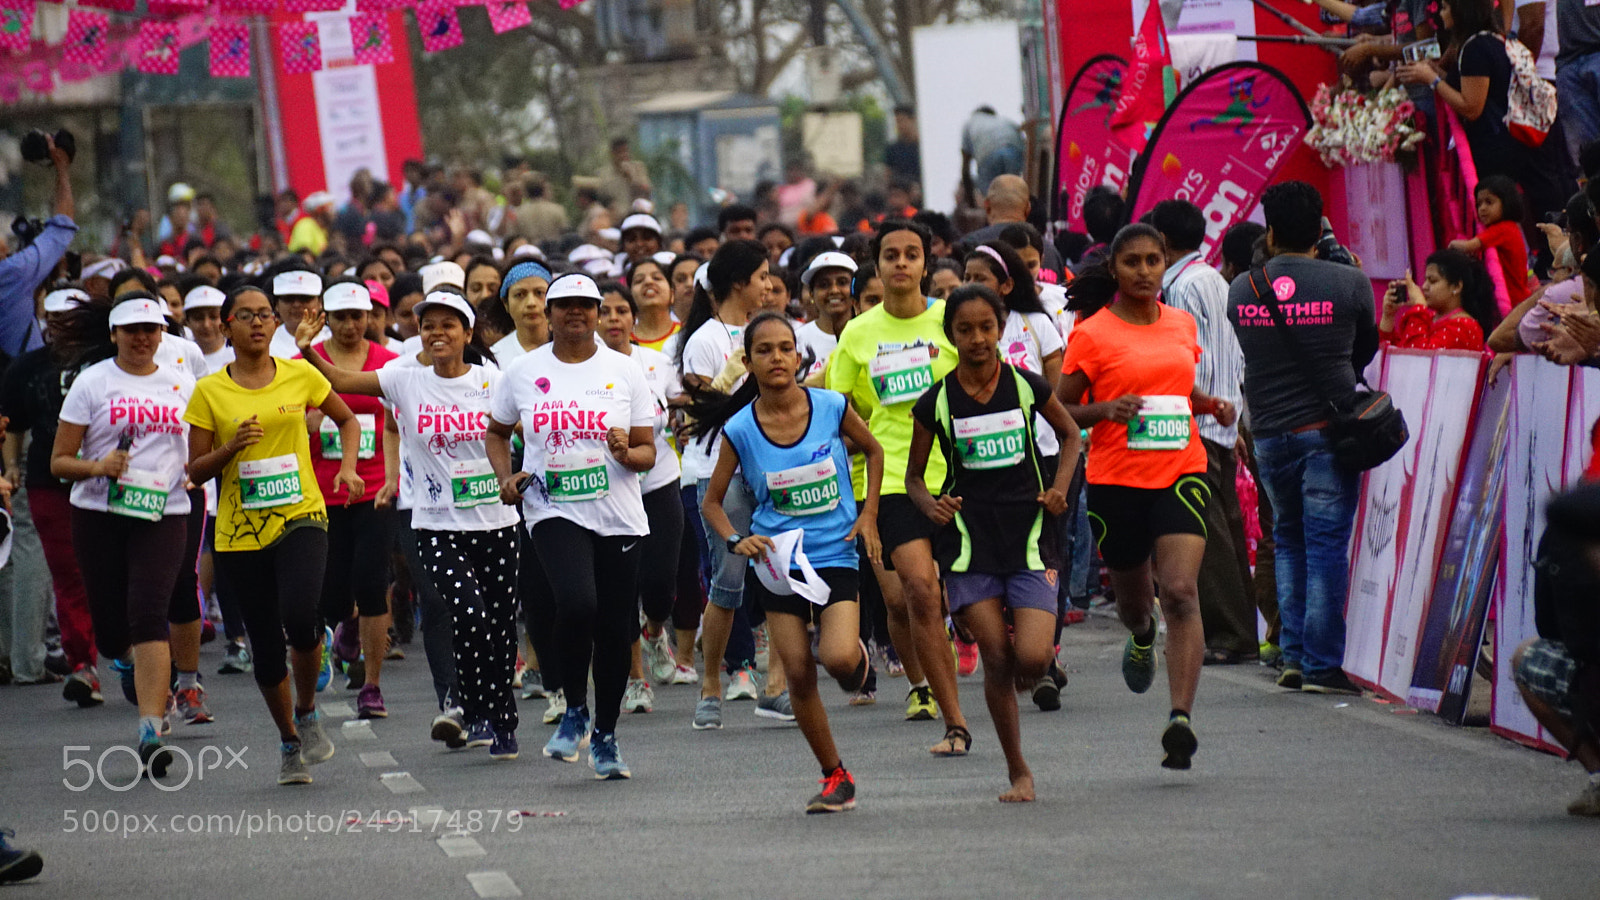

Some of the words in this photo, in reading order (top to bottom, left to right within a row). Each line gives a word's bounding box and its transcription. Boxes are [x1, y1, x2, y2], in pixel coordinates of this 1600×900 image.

[1072, 154, 1096, 219] colors
[1174, 169, 1203, 201] ors
[1253, 318, 1275, 327] WILL
[1285, 318, 1294, 326] O
[887, 369, 932, 393] 50104
[118, 396, 139, 405] AM
[585, 388, 614, 396] colors
[110, 405, 180, 425] PINK
[419, 403, 422, 413] I
[425, 403, 446, 413] AM
[450, 404, 460, 412] A
[533, 402, 537, 411] I
[541, 400, 563, 411] AM
[568, 400, 579, 408] A
[145, 424, 184, 436] SISTER
[417, 411, 487, 434] PINK
[533, 410, 608, 433] PINK
[1148, 419, 1189, 437] 50096
[453, 431, 486, 442] SISTE
[571, 430, 607, 442] SISTE
[976, 433, 1023, 458] 50101
[257, 476, 300, 497] 50038
[470, 477, 500, 496] 5005
[562, 471, 606, 491] 50103
[124, 489, 165, 511] 52433
[791, 481, 838, 506] 50040
